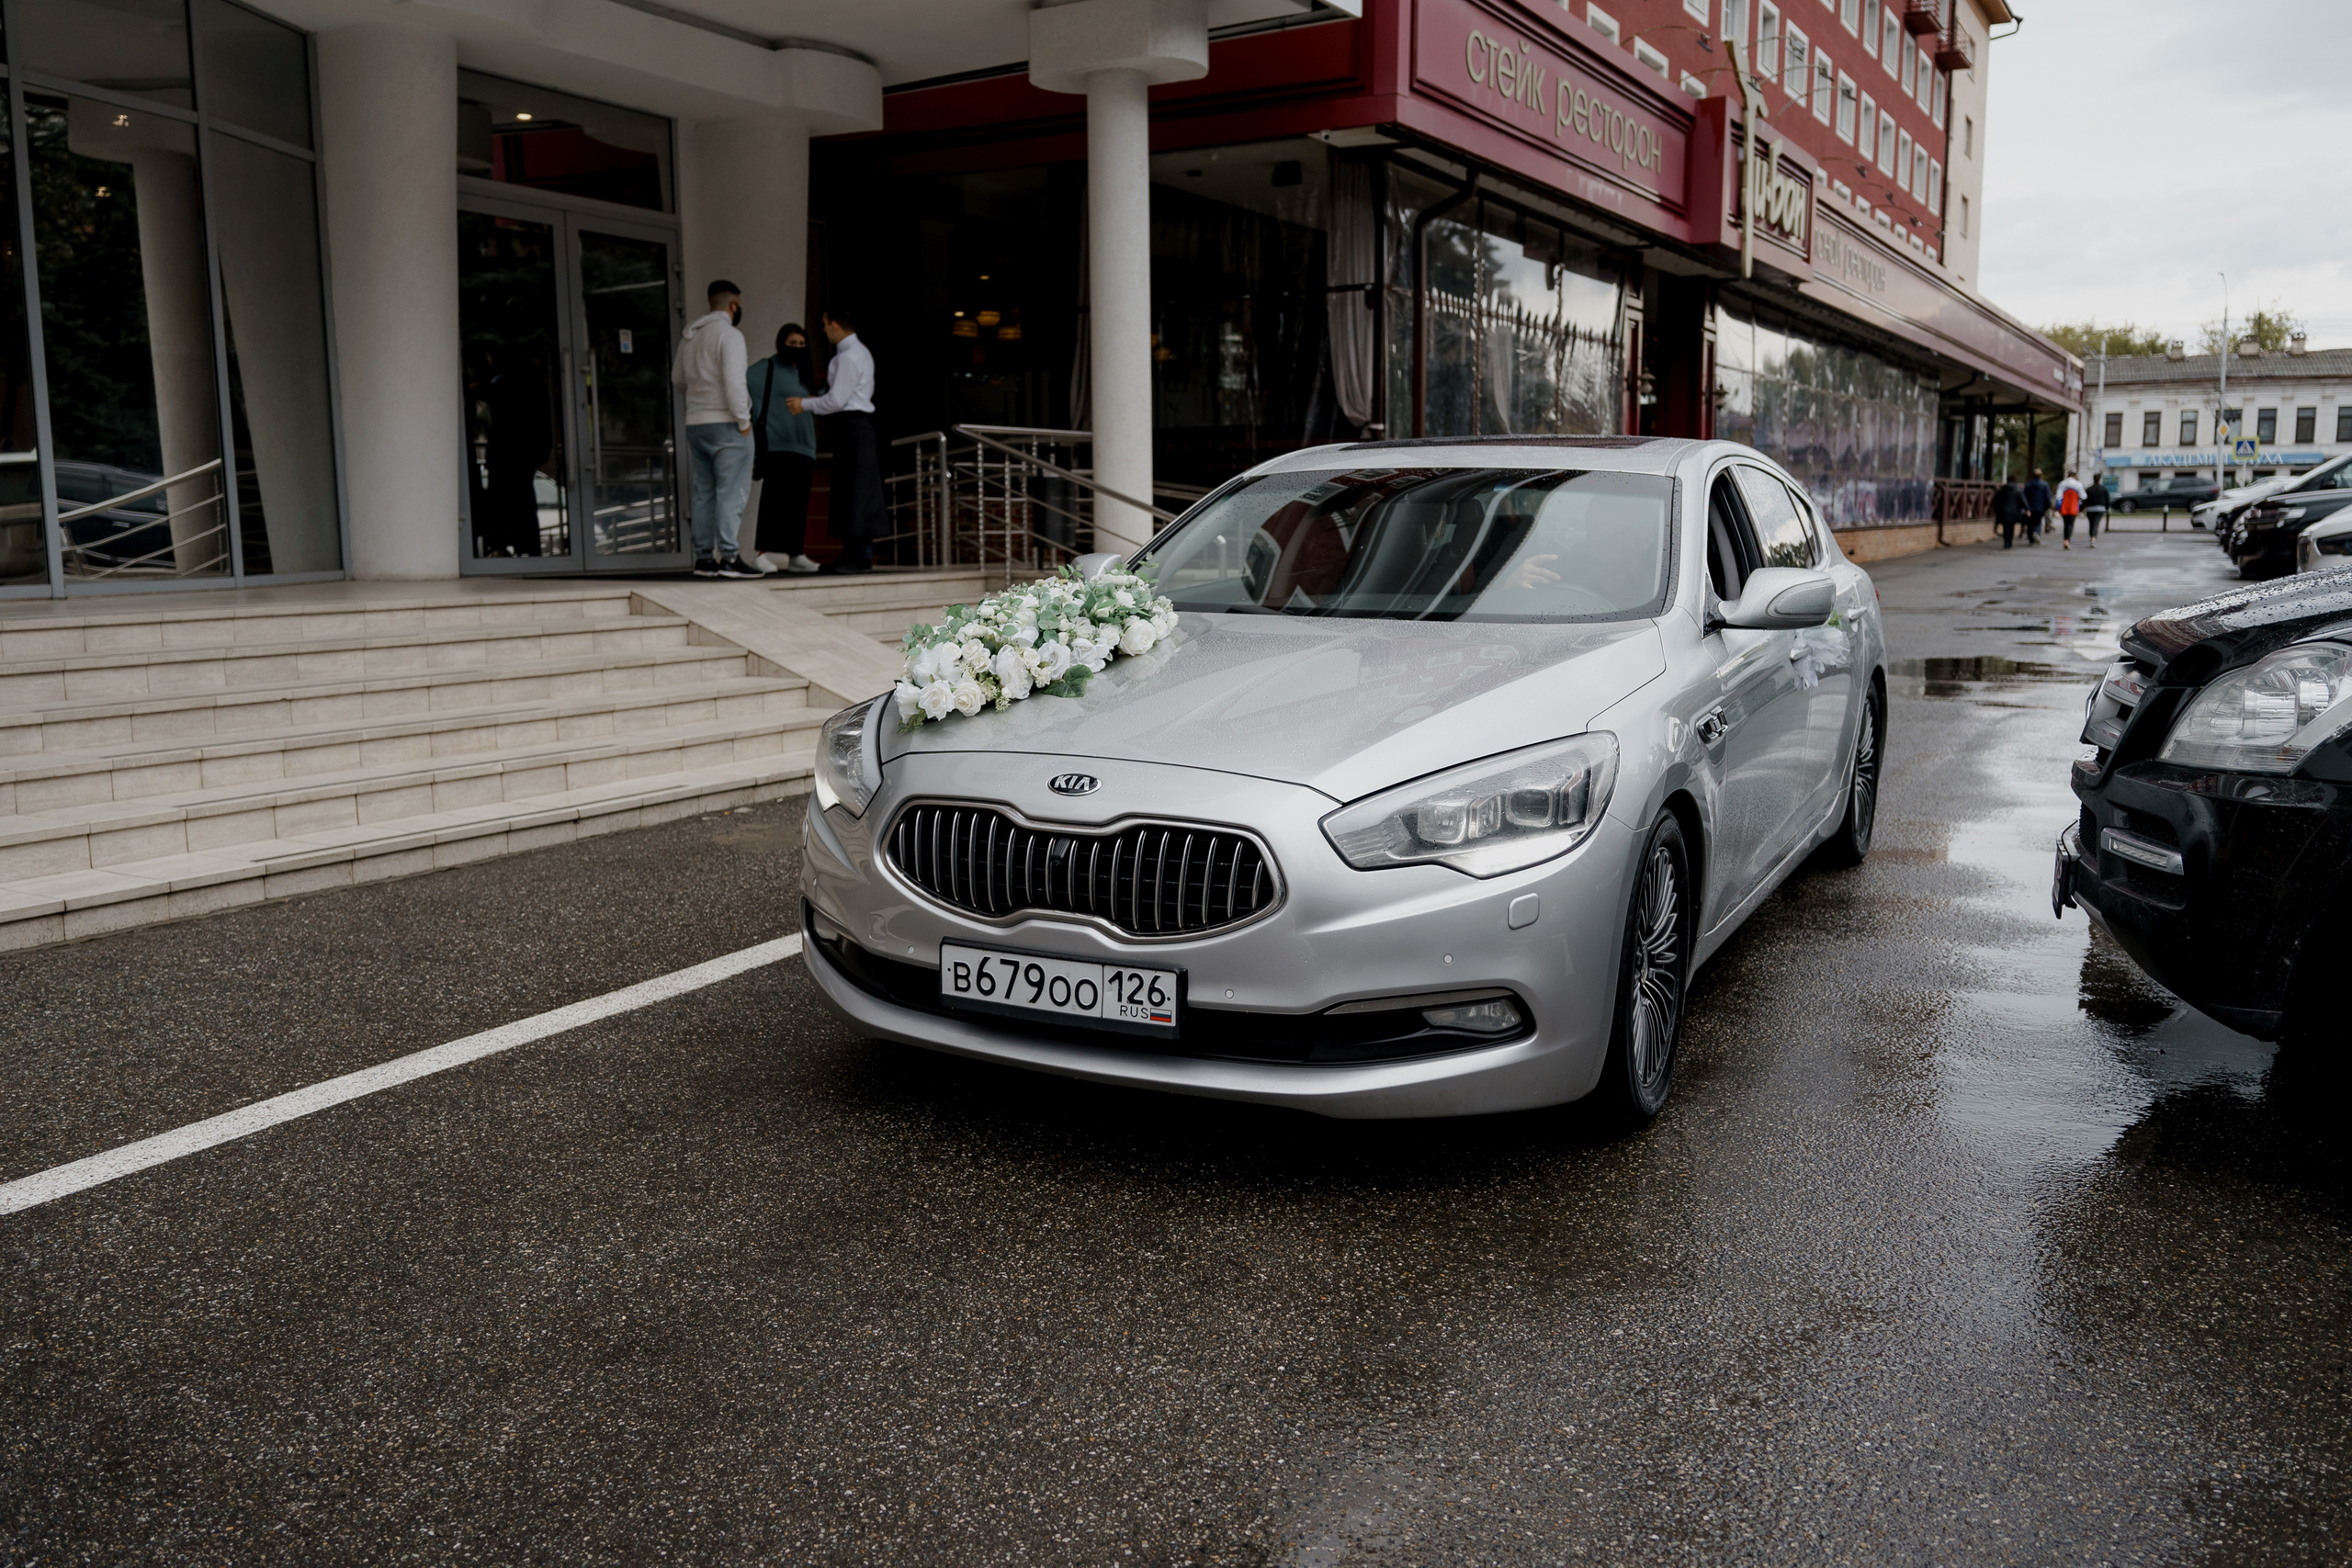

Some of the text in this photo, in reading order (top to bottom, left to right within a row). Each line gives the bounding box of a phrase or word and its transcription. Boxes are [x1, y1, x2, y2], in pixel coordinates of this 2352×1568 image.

[1465, 28, 1662, 175] стейк ресторан
[1843, 243, 1886, 293] ресторан
[1053, 774, 1091, 791] KIA
[1107, 970, 1166, 1007] 126
[1120, 1005, 1149, 1020] RUS
